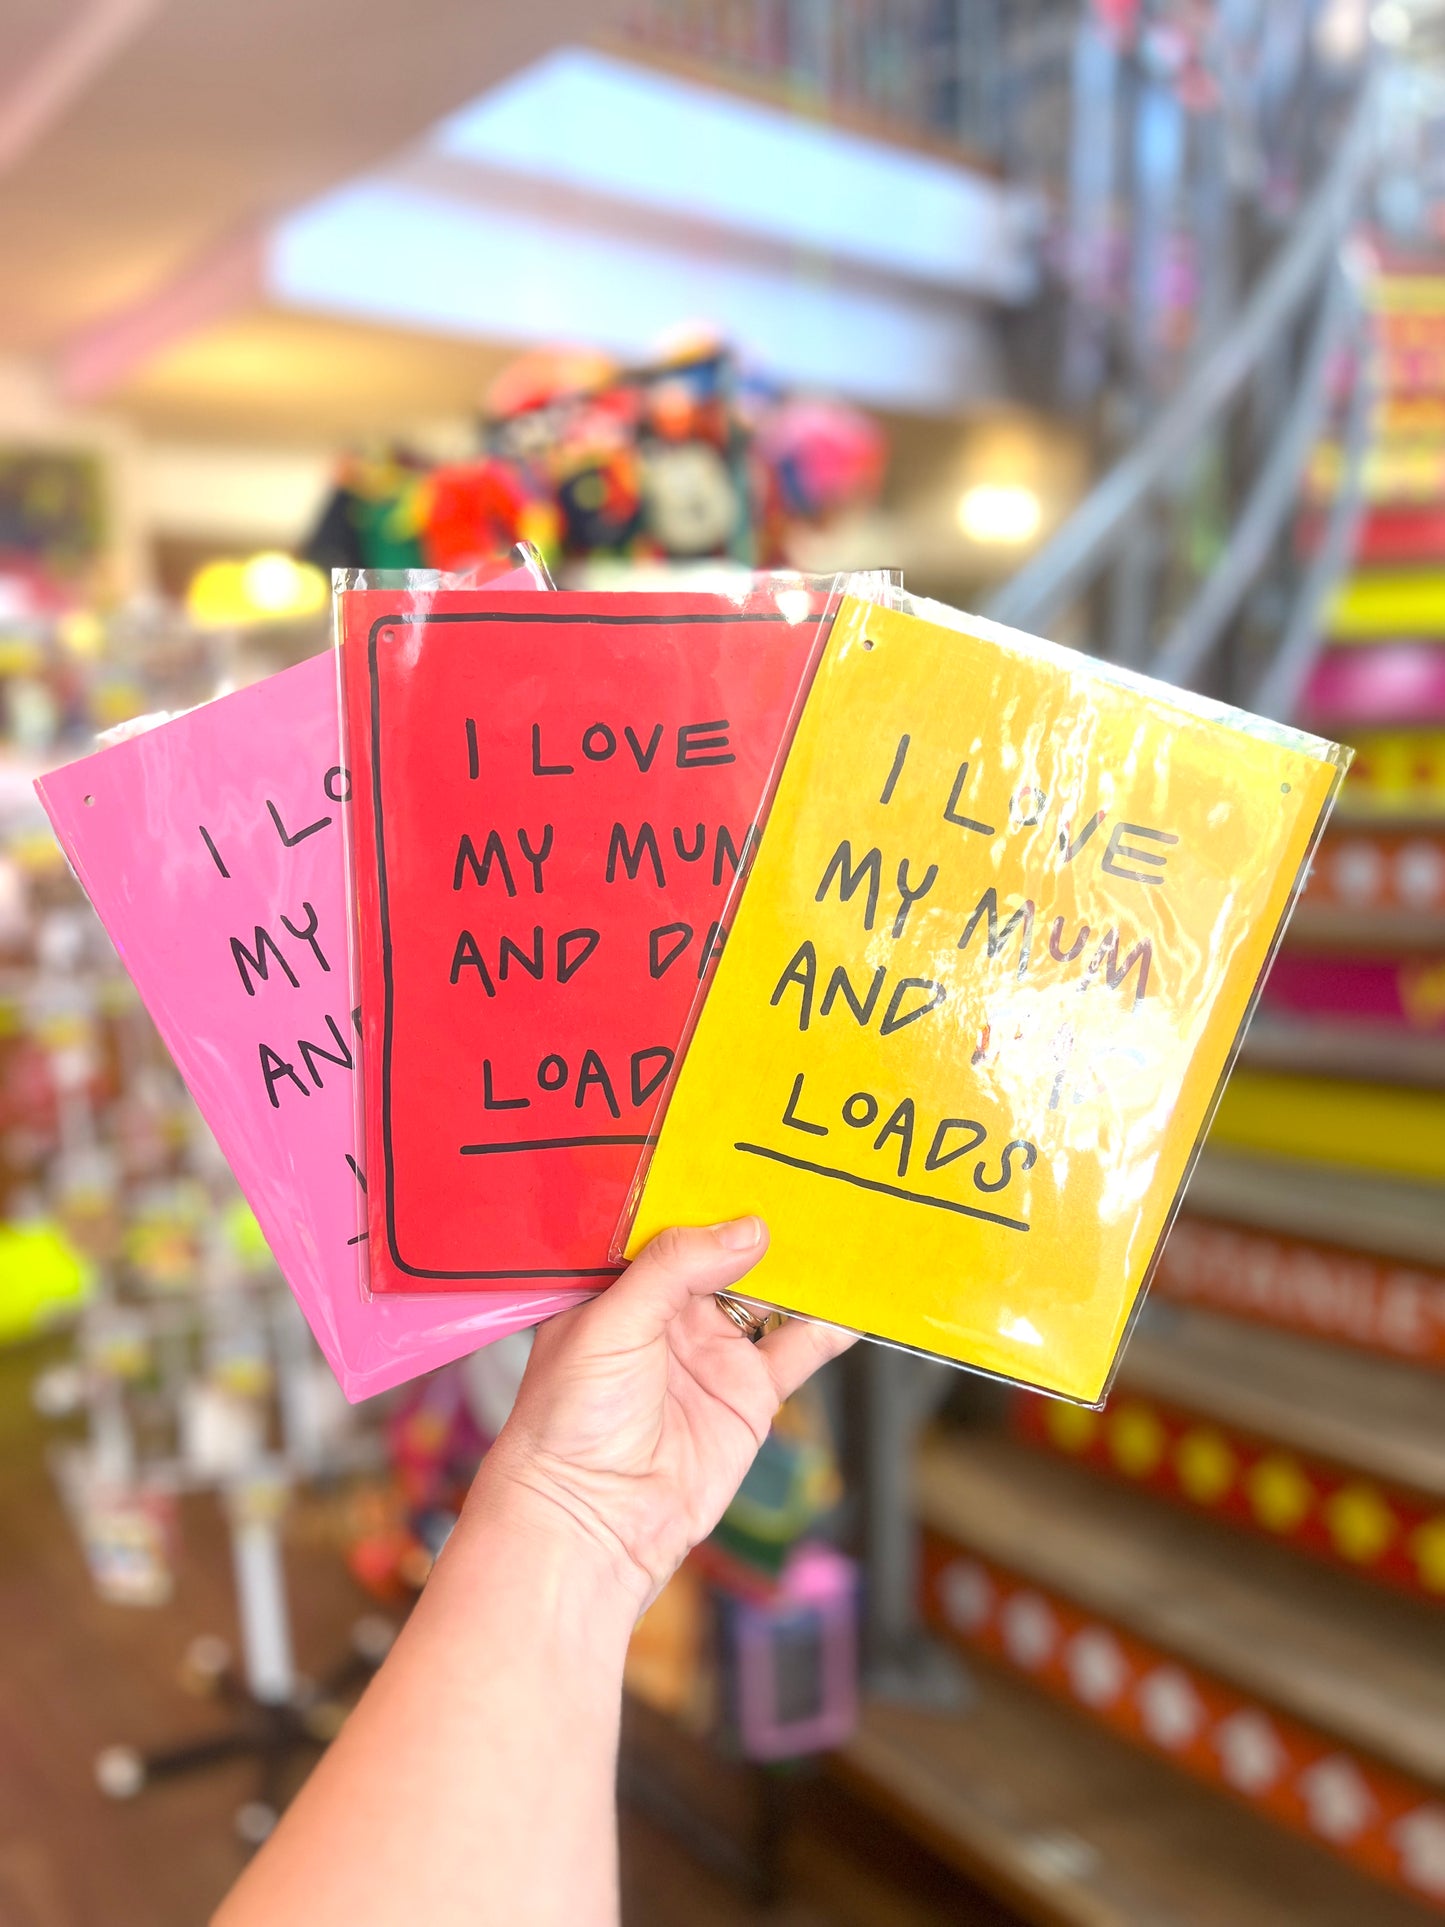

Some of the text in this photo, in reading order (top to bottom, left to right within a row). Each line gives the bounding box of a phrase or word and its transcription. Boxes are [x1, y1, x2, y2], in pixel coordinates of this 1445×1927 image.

[465, 718, 736, 780] I LOVE
[199, 825, 231, 878] I
[879, 735, 1179, 885] I LOVE
[453, 824, 554, 898] MY
[229, 902, 331, 996] MY
[449, 925, 601, 998] AND
[815, 840, 1153, 1012] MY MUM
[769, 940, 948, 1036] AND
[258, 1006, 363, 1108] AN
[782, 1072, 1038, 1193] LOADS
